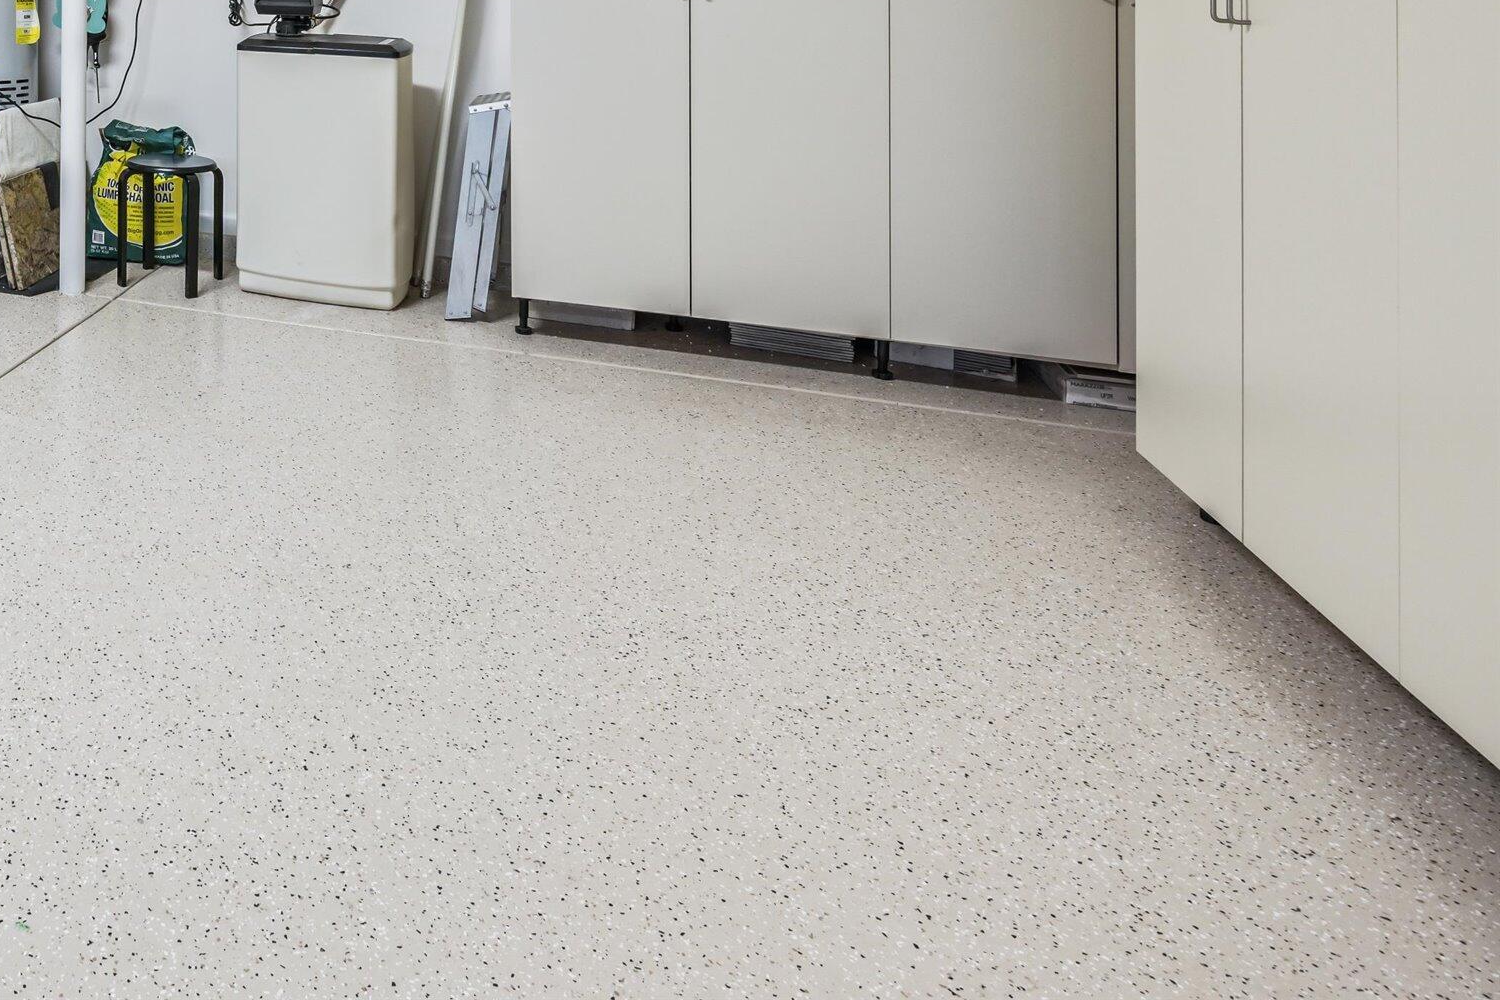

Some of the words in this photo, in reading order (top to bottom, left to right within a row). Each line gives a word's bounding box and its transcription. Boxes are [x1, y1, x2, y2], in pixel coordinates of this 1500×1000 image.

[107, 178, 130, 190] 100
[133, 182, 175, 192] ORANIC
[97, 187, 119, 200] LUMP
[126, 192, 175, 203] HAOAL
